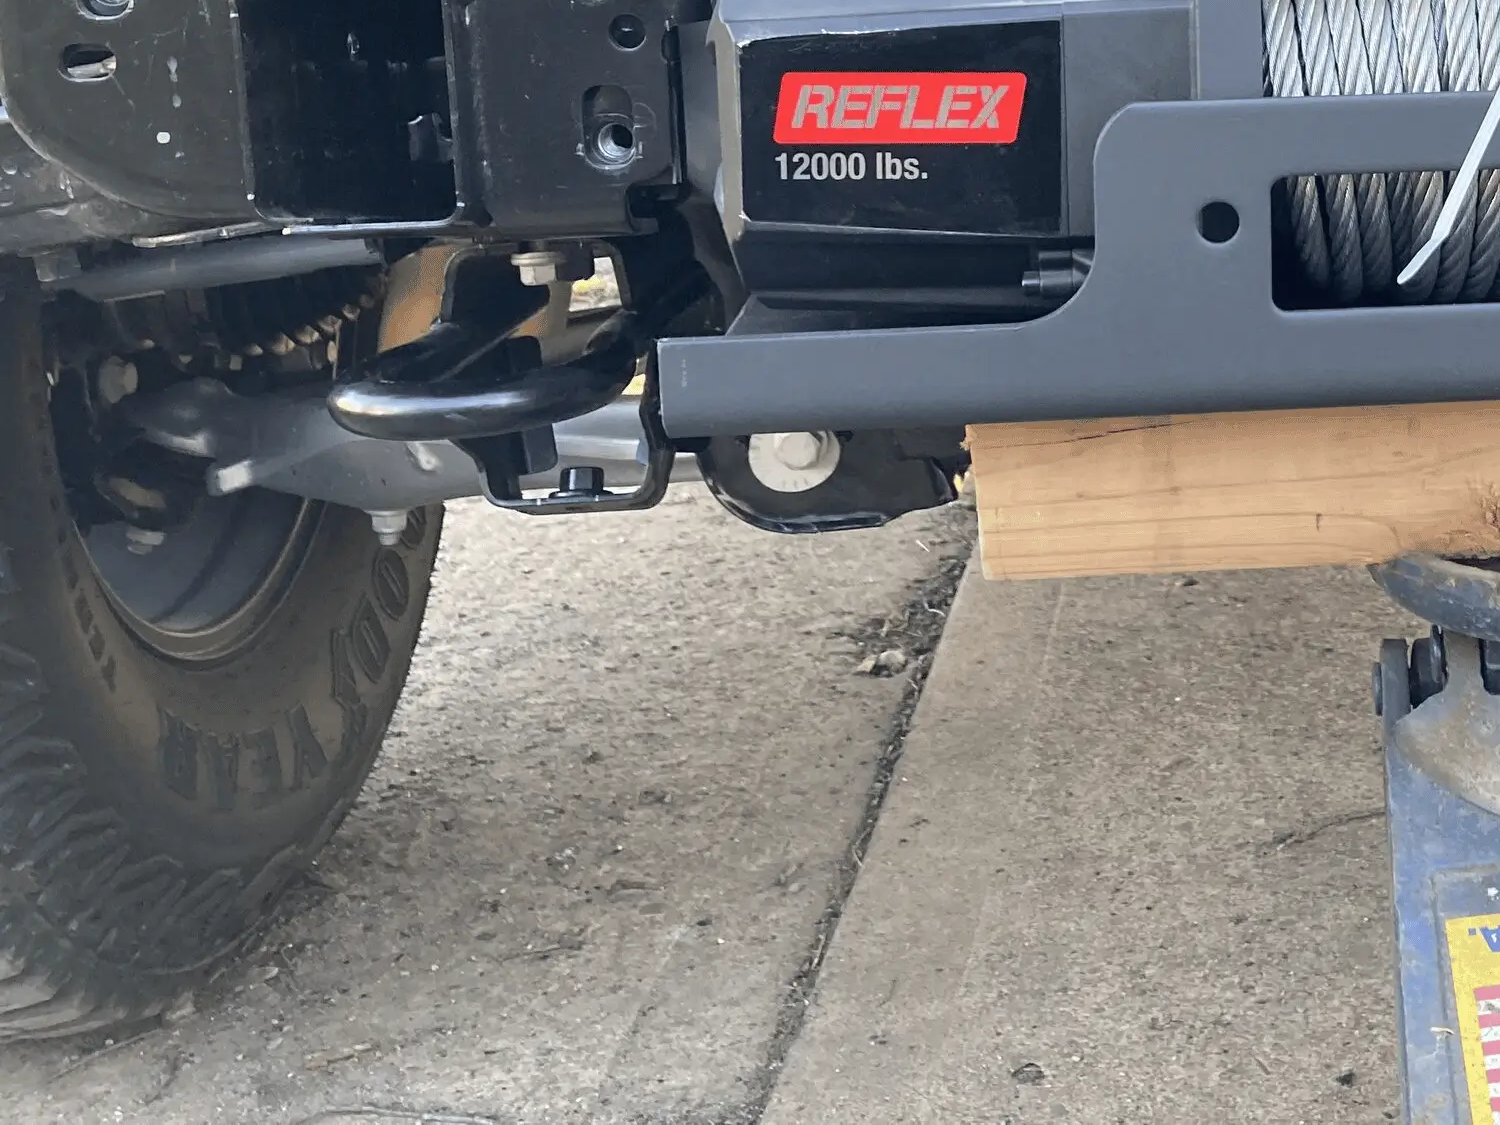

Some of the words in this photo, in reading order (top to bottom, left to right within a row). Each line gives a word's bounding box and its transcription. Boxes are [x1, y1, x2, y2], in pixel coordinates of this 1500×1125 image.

[791, 85, 1010, 129] REFLEX
[774, 152, 866, 180] 12000
[875, 152, 928, 180] lbs.
